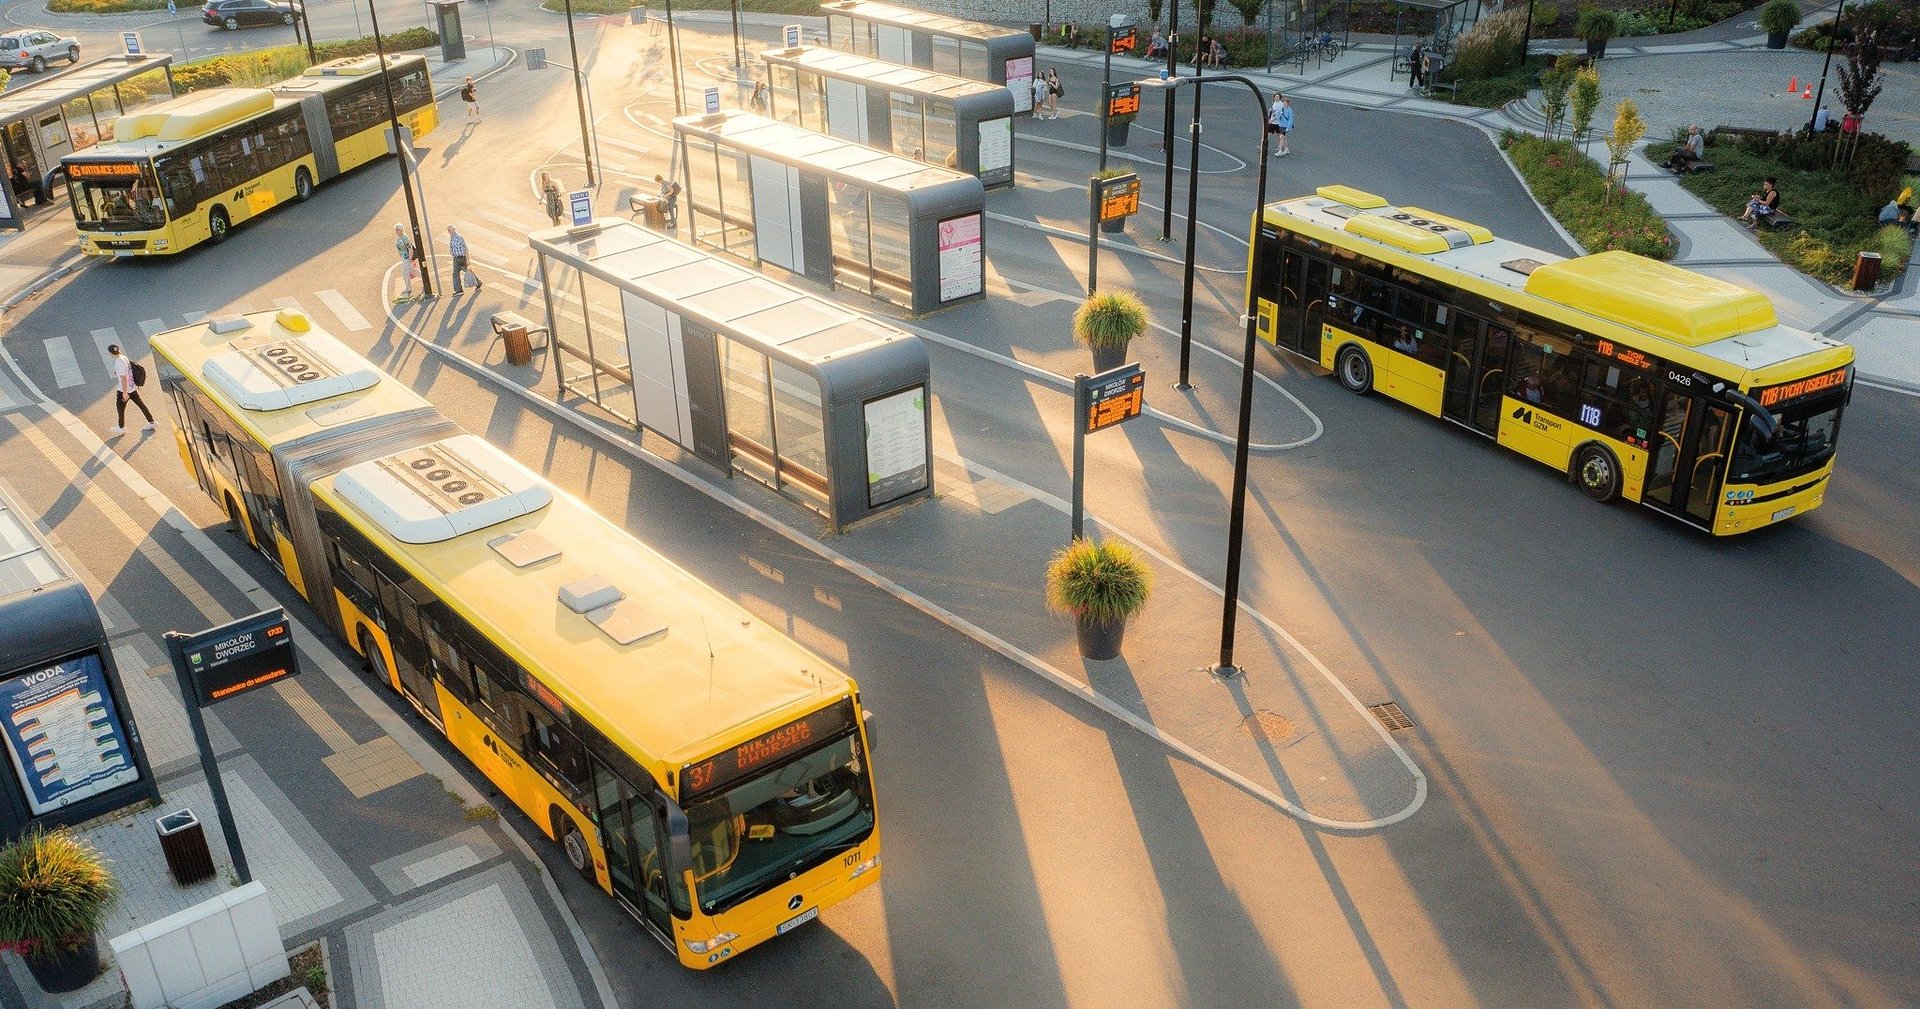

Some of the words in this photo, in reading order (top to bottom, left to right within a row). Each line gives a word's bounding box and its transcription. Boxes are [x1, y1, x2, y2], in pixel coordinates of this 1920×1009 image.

[1598, 341, 1614, 356] M18
[1668, 371, 1692, 387] 0426
[1760, 386, 1779, 406] M18
[1780, 381, 1806, 400] TYCHY
[1805, 372, 1835, 392] OSIEDLE
[1535, 413, 1562, 430] Transport
[1581, 404, 1600, 426] M18
[1533, 421, 1548, 432] GZM
[215, 633, 253, 652] MIKOŁÓW
[215, 641, 256, 659] DWORZEC
[21, 665, 65, 687] WODA
[690, 761, 714, 791] 37
[842, 851, 861, 867] 1011
